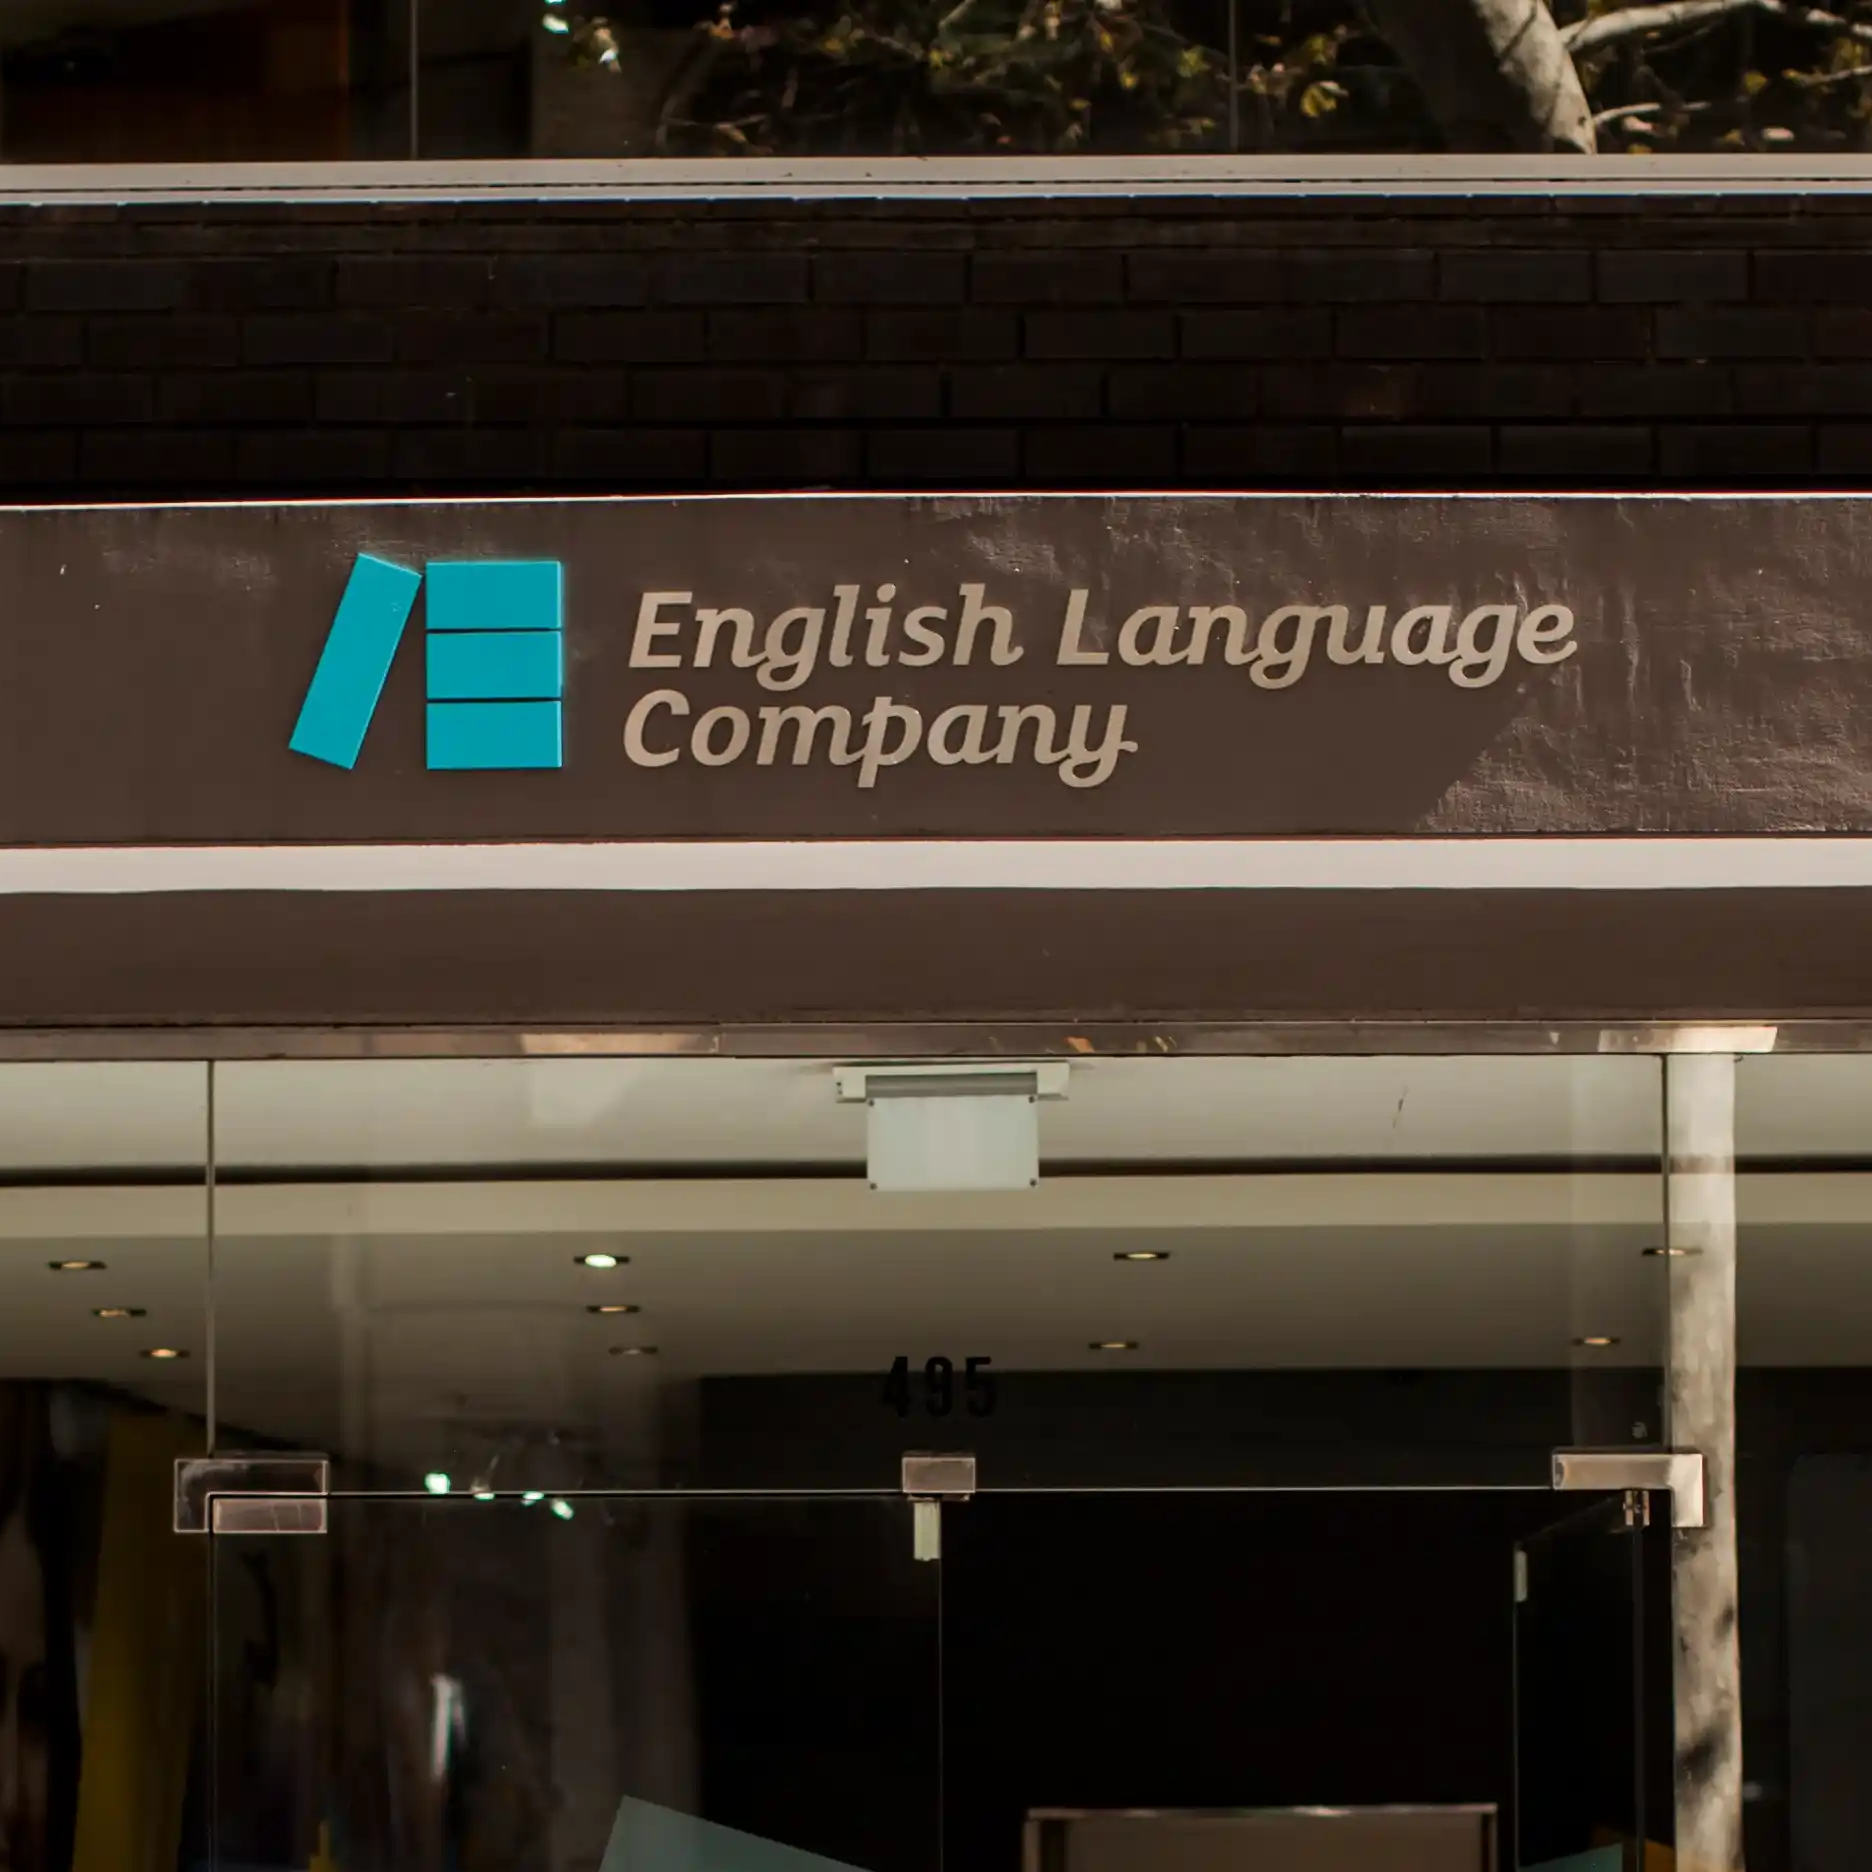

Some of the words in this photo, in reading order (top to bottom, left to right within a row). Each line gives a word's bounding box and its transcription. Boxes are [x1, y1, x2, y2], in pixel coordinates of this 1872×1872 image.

[628, 583, 1024, 689] English
[1056, 588, 1578, 690] Language
[622, 687, 1139, 789] Company
[881, 1356, 997, 1418] 495
